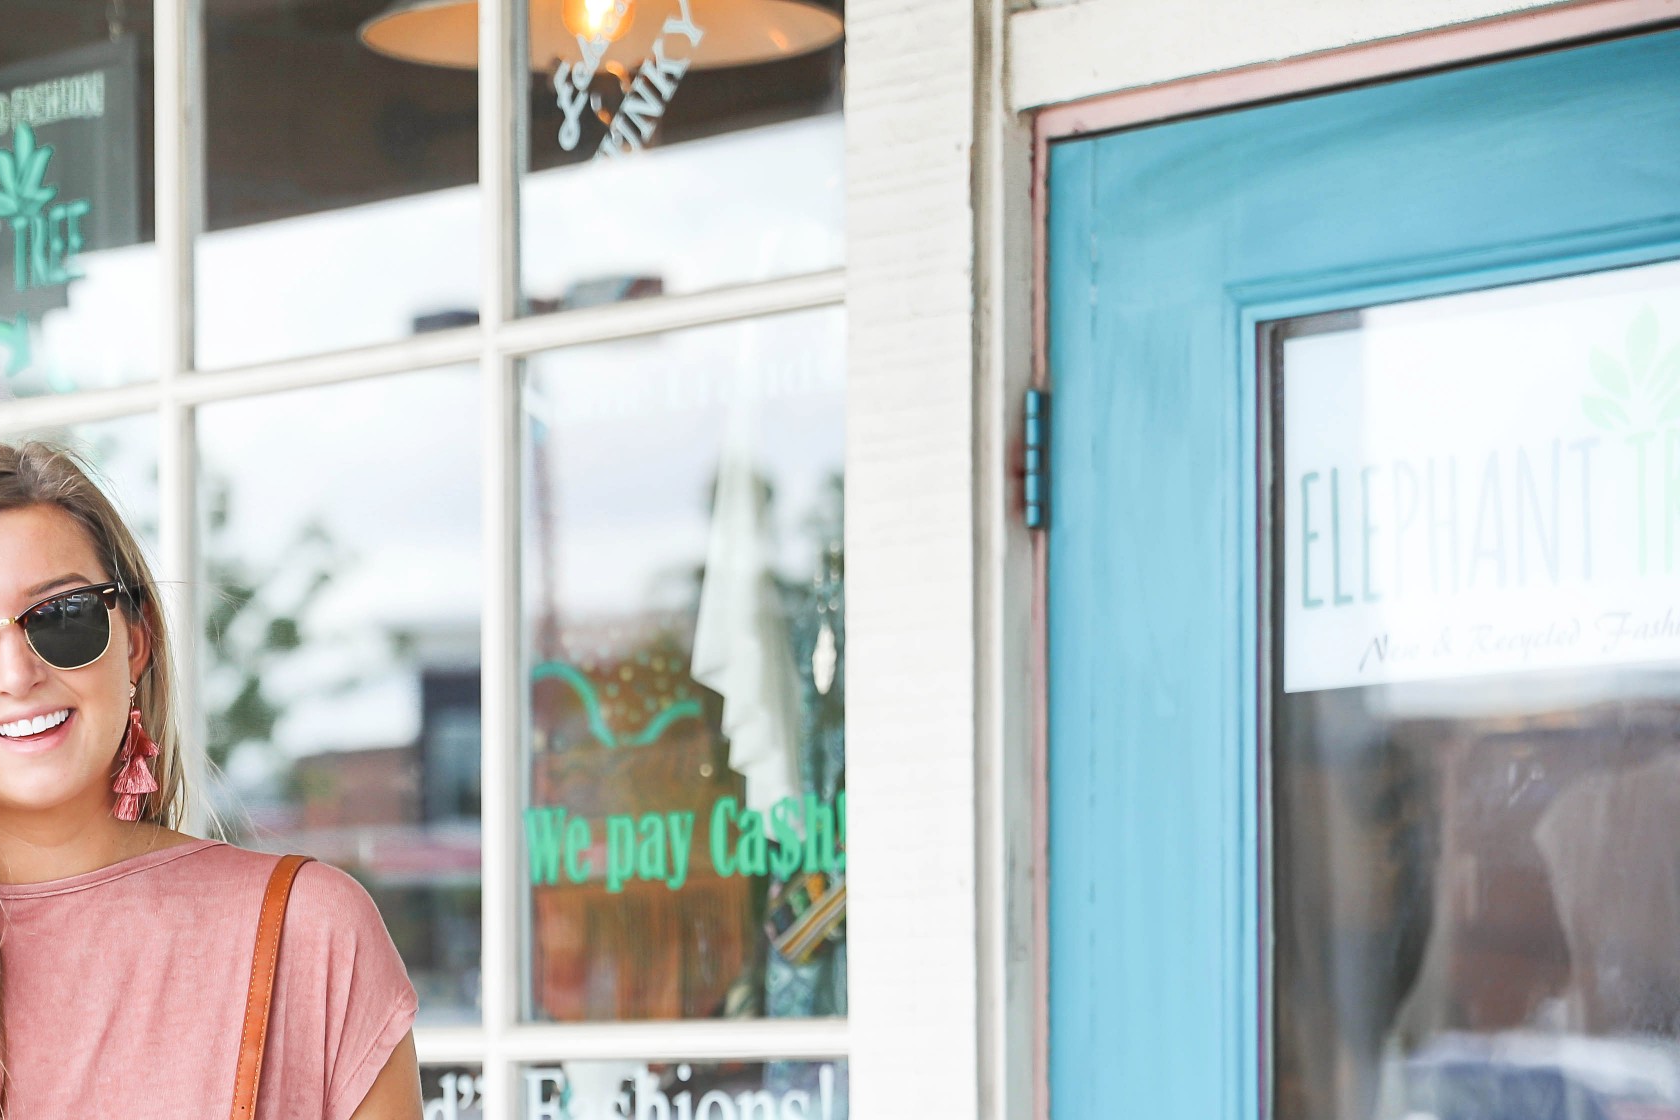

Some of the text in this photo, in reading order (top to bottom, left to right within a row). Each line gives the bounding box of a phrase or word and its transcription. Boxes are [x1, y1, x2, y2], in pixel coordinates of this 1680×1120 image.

[592, 0, 704, 164] UNKY
[9, 198, 91, 293] TREE
[1301, 437, 1600, 609] ELEPHANT
[523, 804, 591, 886] We
[606, 811, 695, 894] pay
